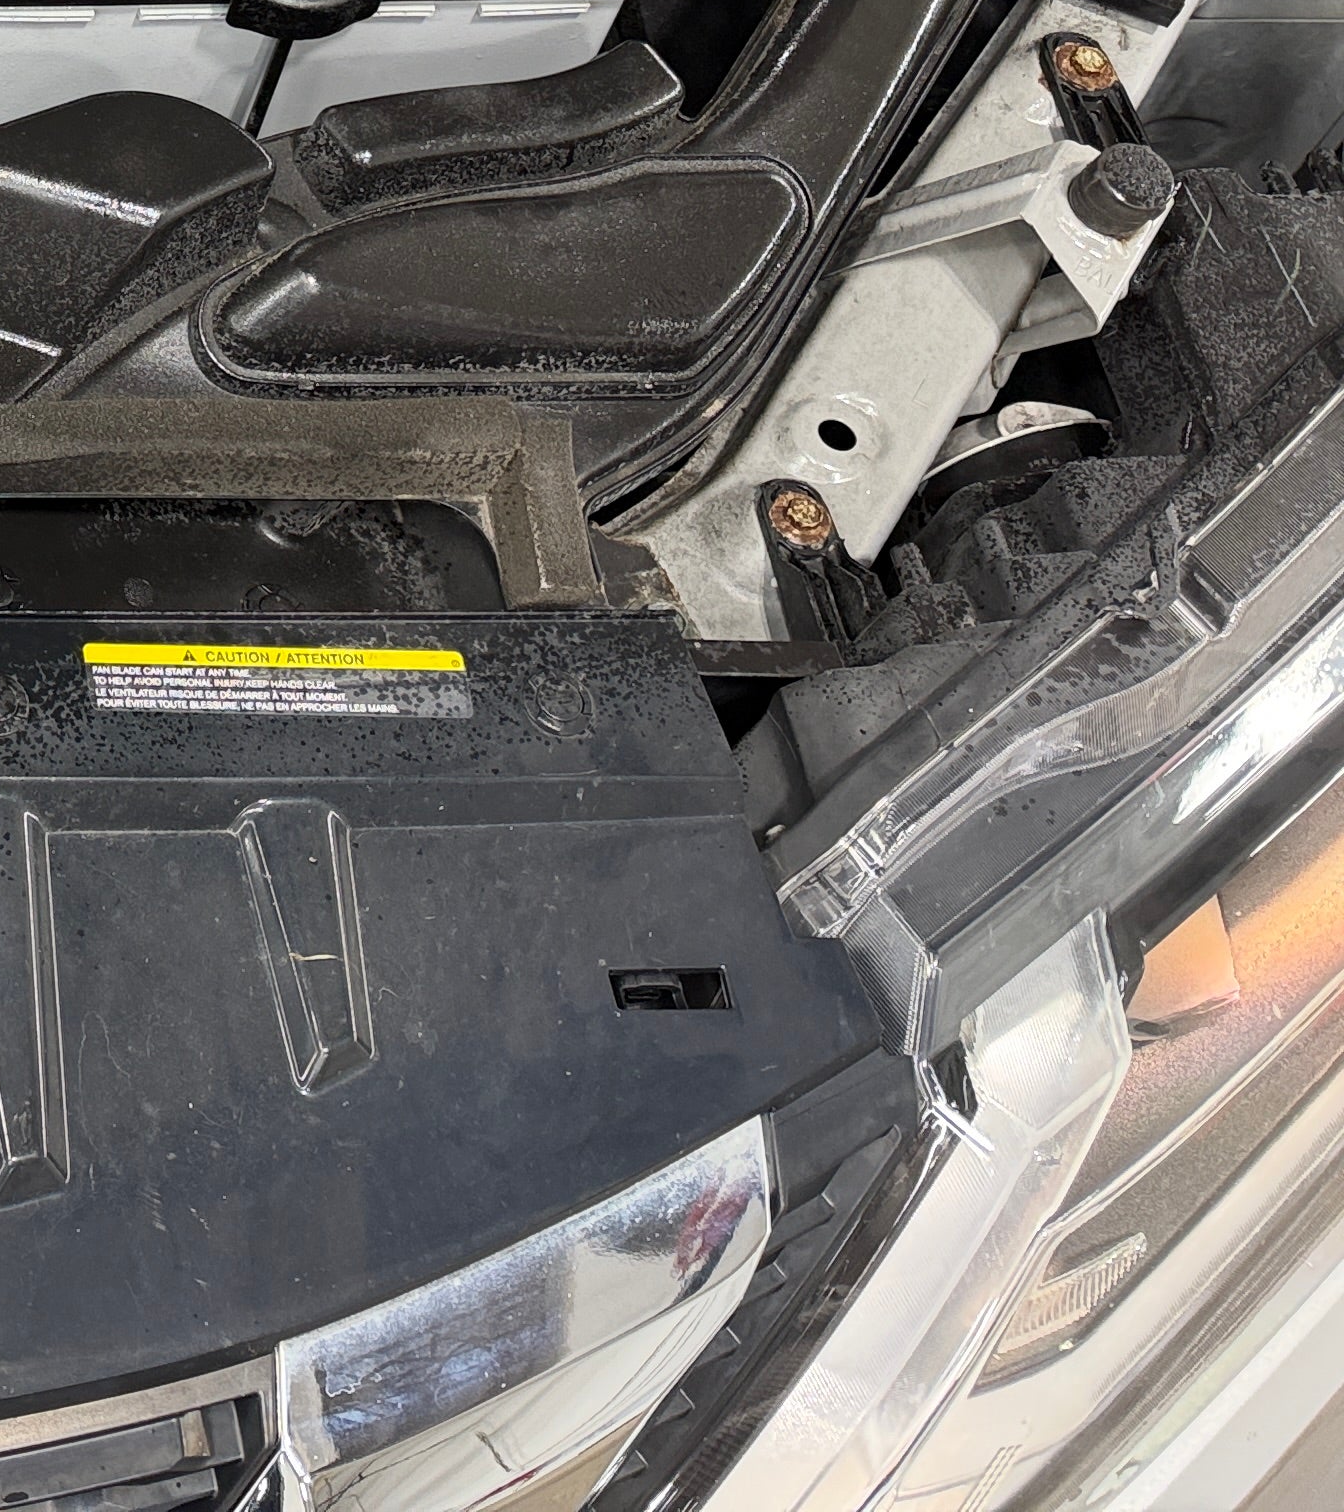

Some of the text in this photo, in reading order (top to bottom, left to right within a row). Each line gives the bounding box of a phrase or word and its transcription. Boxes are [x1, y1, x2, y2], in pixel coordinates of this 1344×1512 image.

[206, 651, 365, 665] CAUTION / ATTENTION
[92, 666, 251, 677] FAN BLADE CAN START AT ANY TIME.
[94, 676, 107, 685] TO
[108, 676, 132, 686] HELP
[134, 677, 162, 686] AVOID
[163, 678, 213, 687] PERSONAL
[271, 680, 303, 689] HANDS
[304, 681, 337, 690] CLEAR.
[95, 688, 107, 696] LE
[108, 689, 167, 698] VENTILATEUR
[169, 690, 204, 698] RISQUE
[206, 690, 218, 699] DE
[219, 689, 271, 699] DÉMARRER
[280, 692, 304, 701] TOUT
[306, 693, 348, 702] MOMENT.
[97, 697, 399, 713] POUR ÉVITER TOUTE BLESSURE, NE PAS EN APPROCHER LES MAINS.
